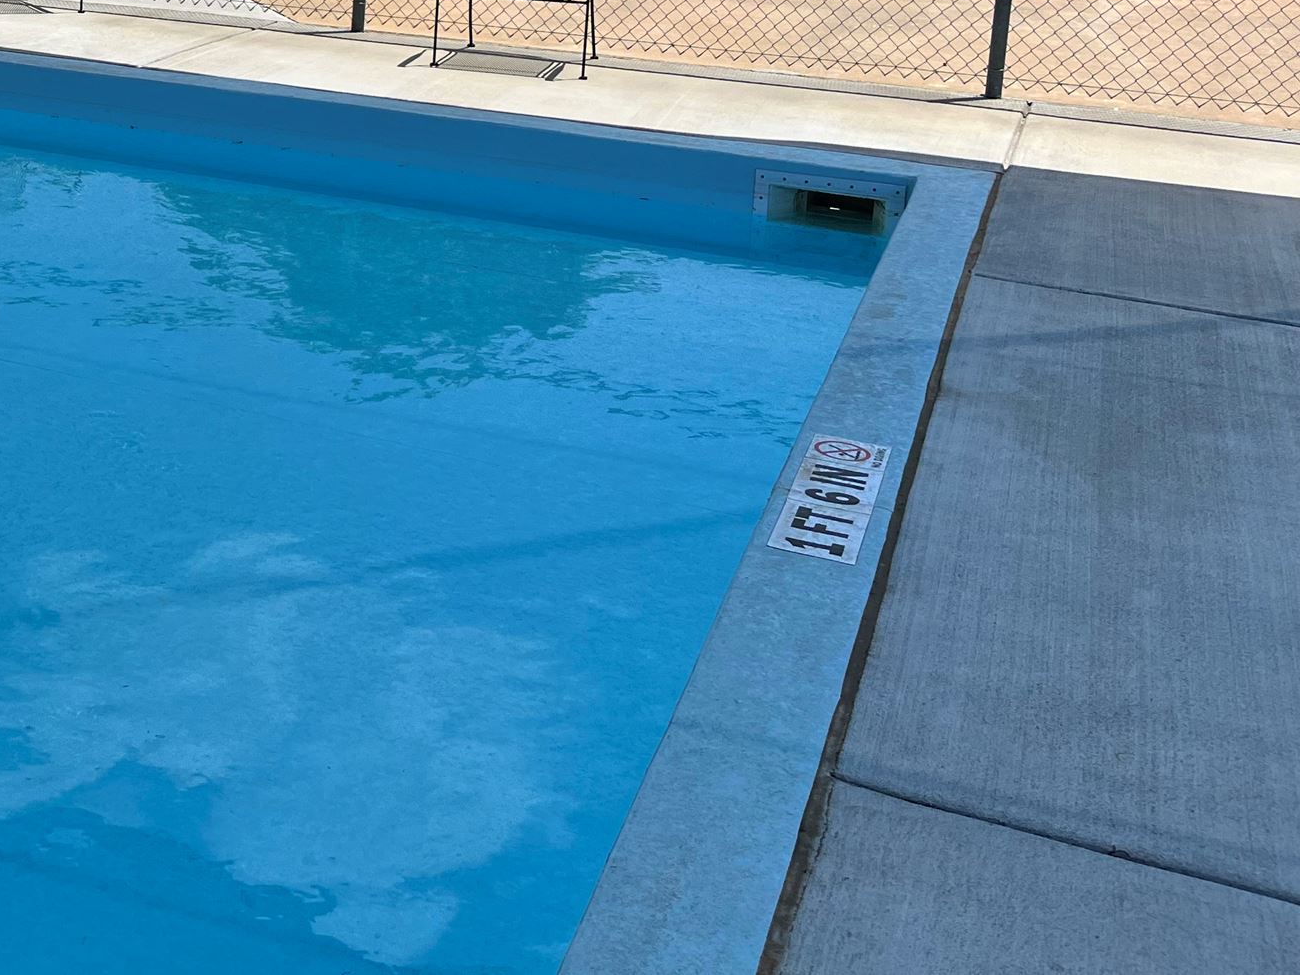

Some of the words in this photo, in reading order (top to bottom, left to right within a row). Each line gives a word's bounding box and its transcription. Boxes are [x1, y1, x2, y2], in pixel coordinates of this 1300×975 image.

[810, 463, 869, 491] IN
[805, 488, 860, 506] 6
[791, 505, 854, 539] FT
[785, 536, 845, 557] 1
